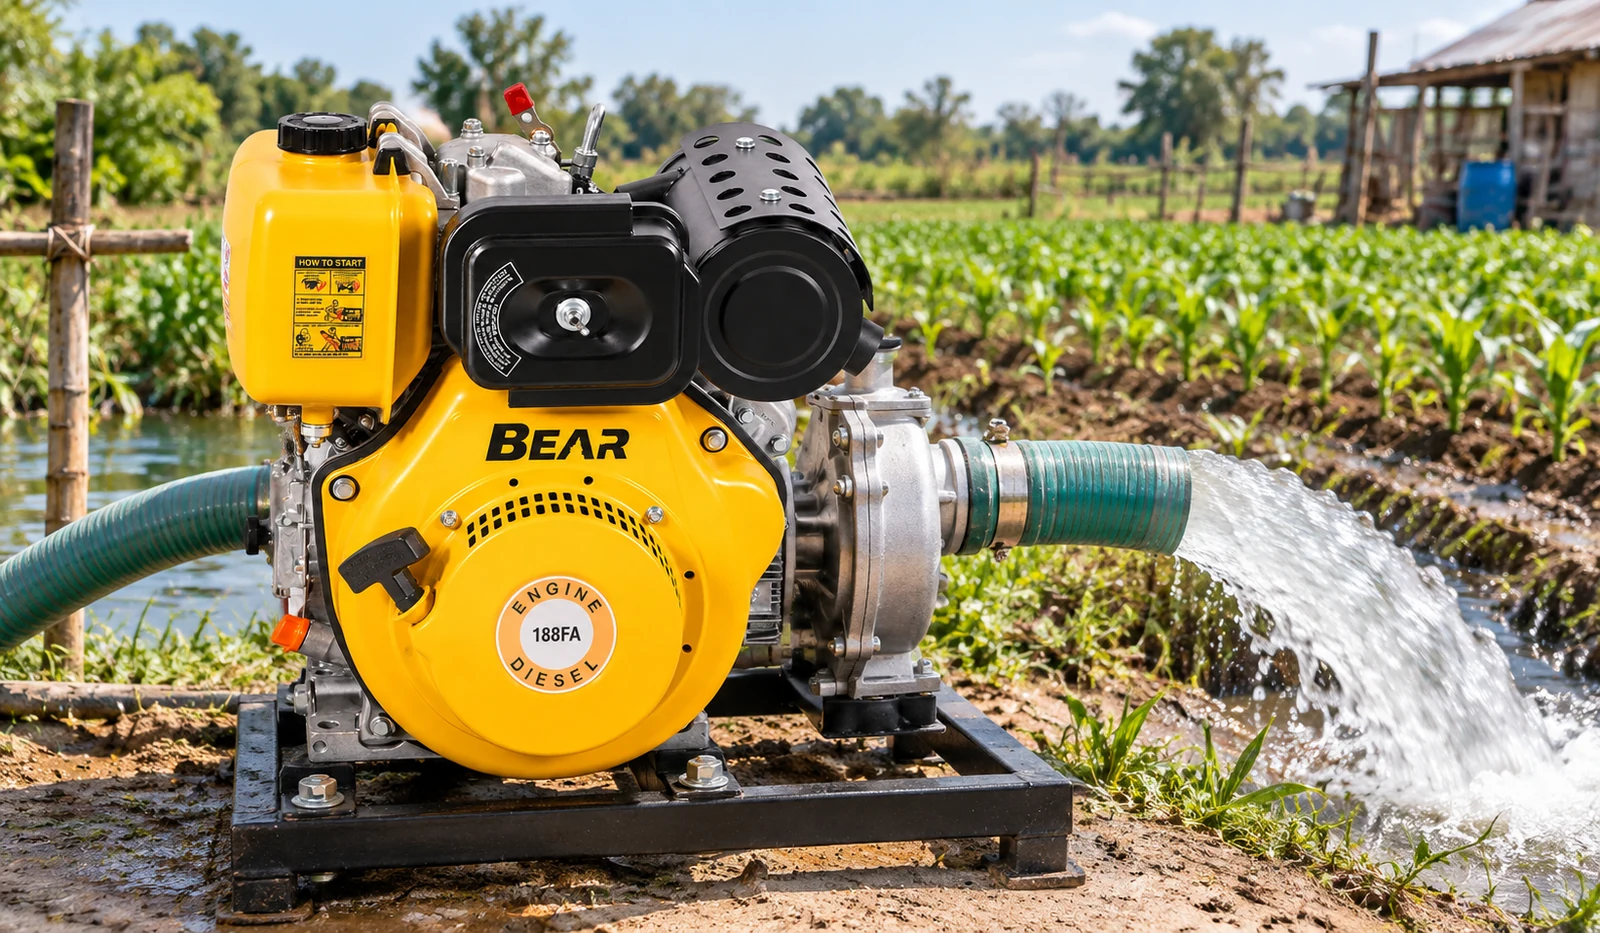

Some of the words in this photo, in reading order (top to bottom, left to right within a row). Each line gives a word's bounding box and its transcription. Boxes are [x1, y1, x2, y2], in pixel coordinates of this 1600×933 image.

[299, 259, 320, 267] HOW
[321, 259, 334, 267] TO
[335, 259, 363, 267] START
[485, 423, 630, 461] BEAR
[511, 582, 603, 615] ENGINE
[532, 626, 582, 642] 188FA
[509, 656, 599, 688] DIESEL
